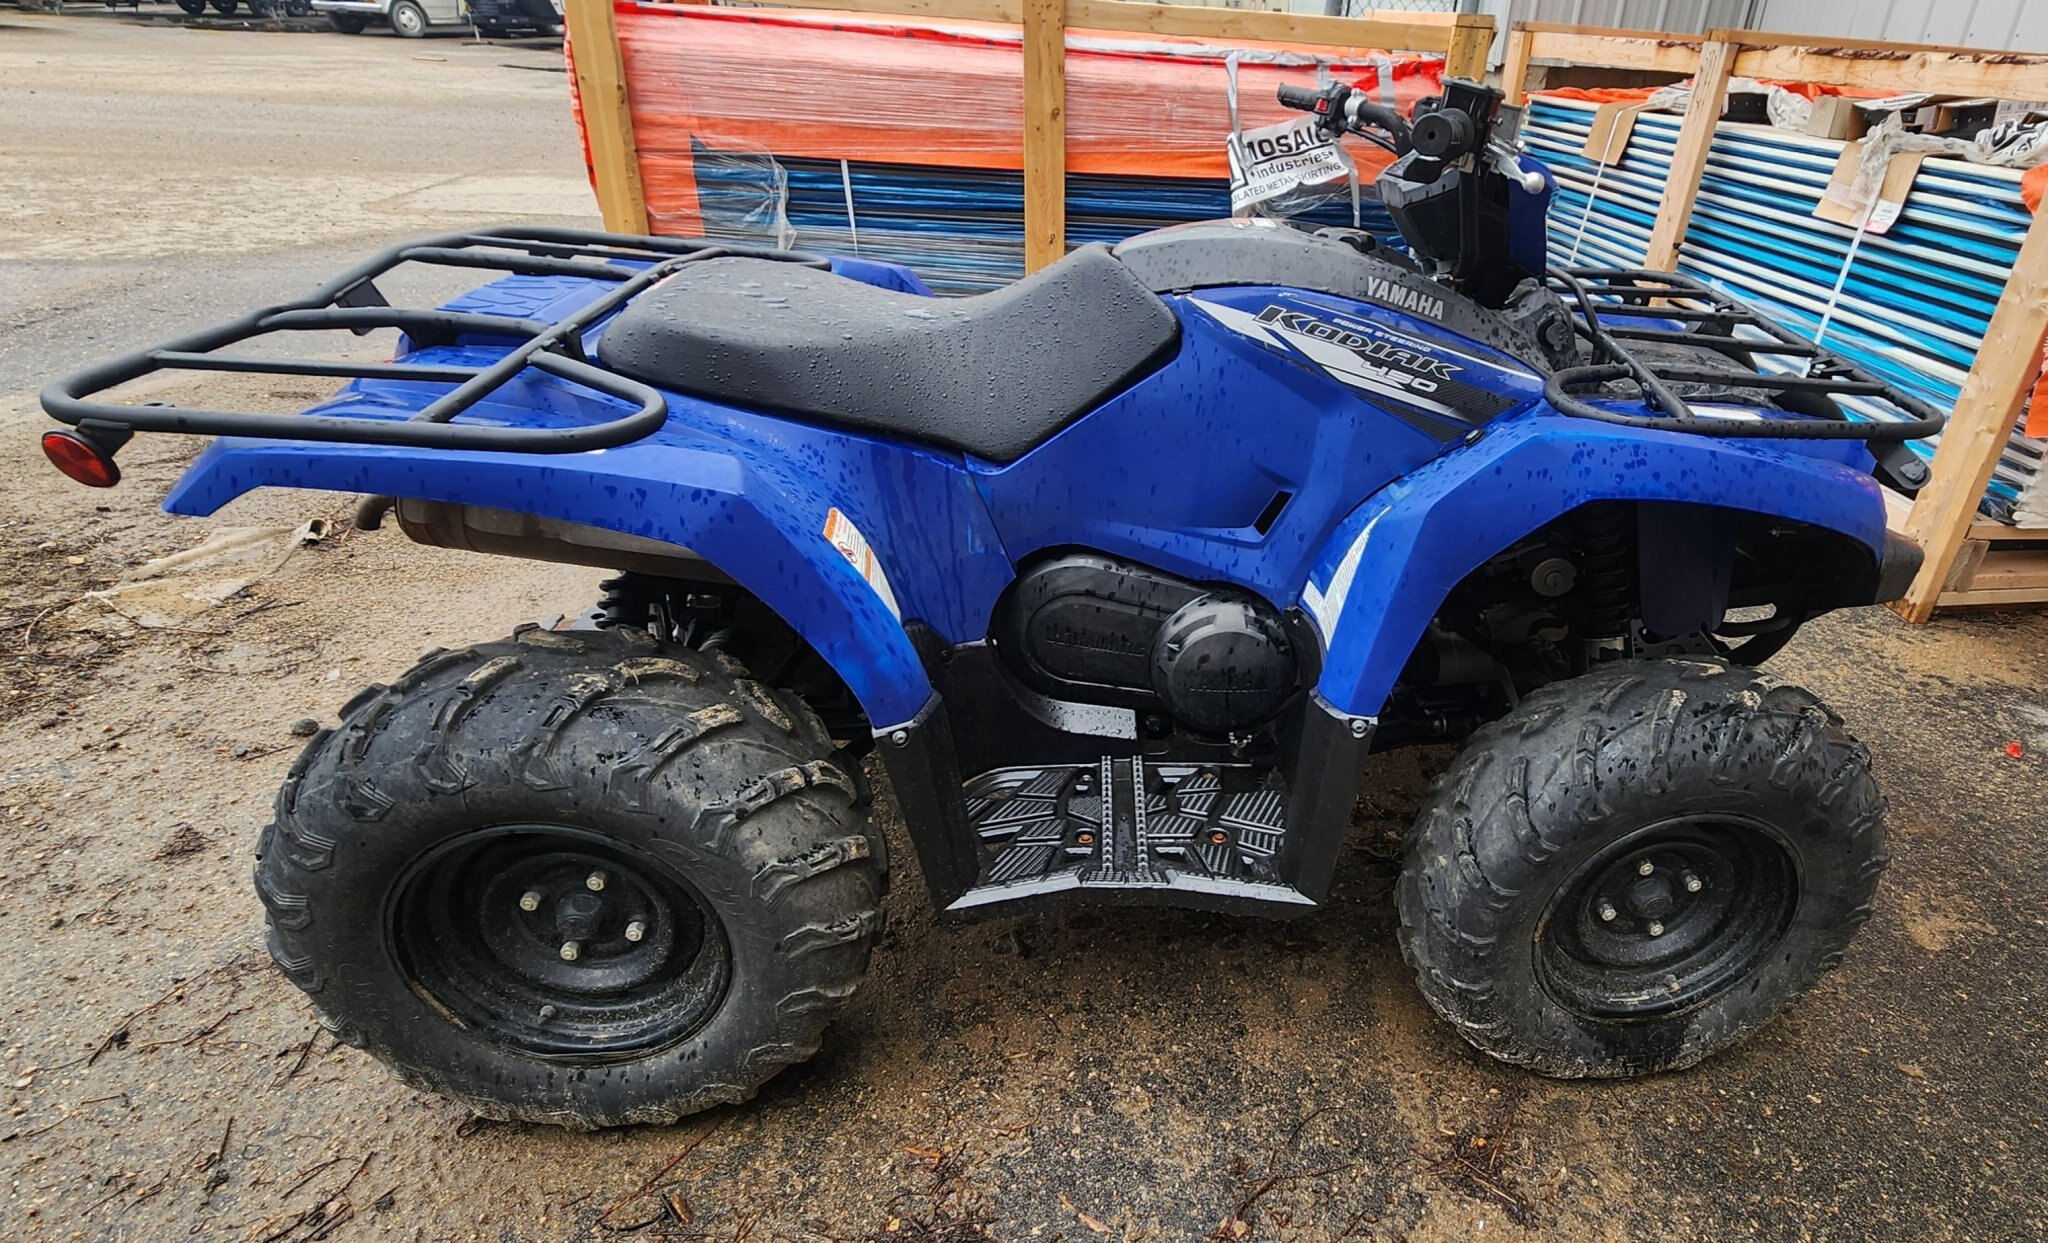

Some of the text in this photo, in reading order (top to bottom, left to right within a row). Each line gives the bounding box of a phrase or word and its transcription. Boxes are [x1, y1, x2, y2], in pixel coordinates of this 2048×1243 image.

[1256, 151, 1329, 179] industries
[1367, 276, 1444, 320] YAMAHA
[1254, 304, 1464, 381] KODIAK
[1332, 317, 1432, 353] POWER STEERING
[1361, 360, 1438, 393] 450
